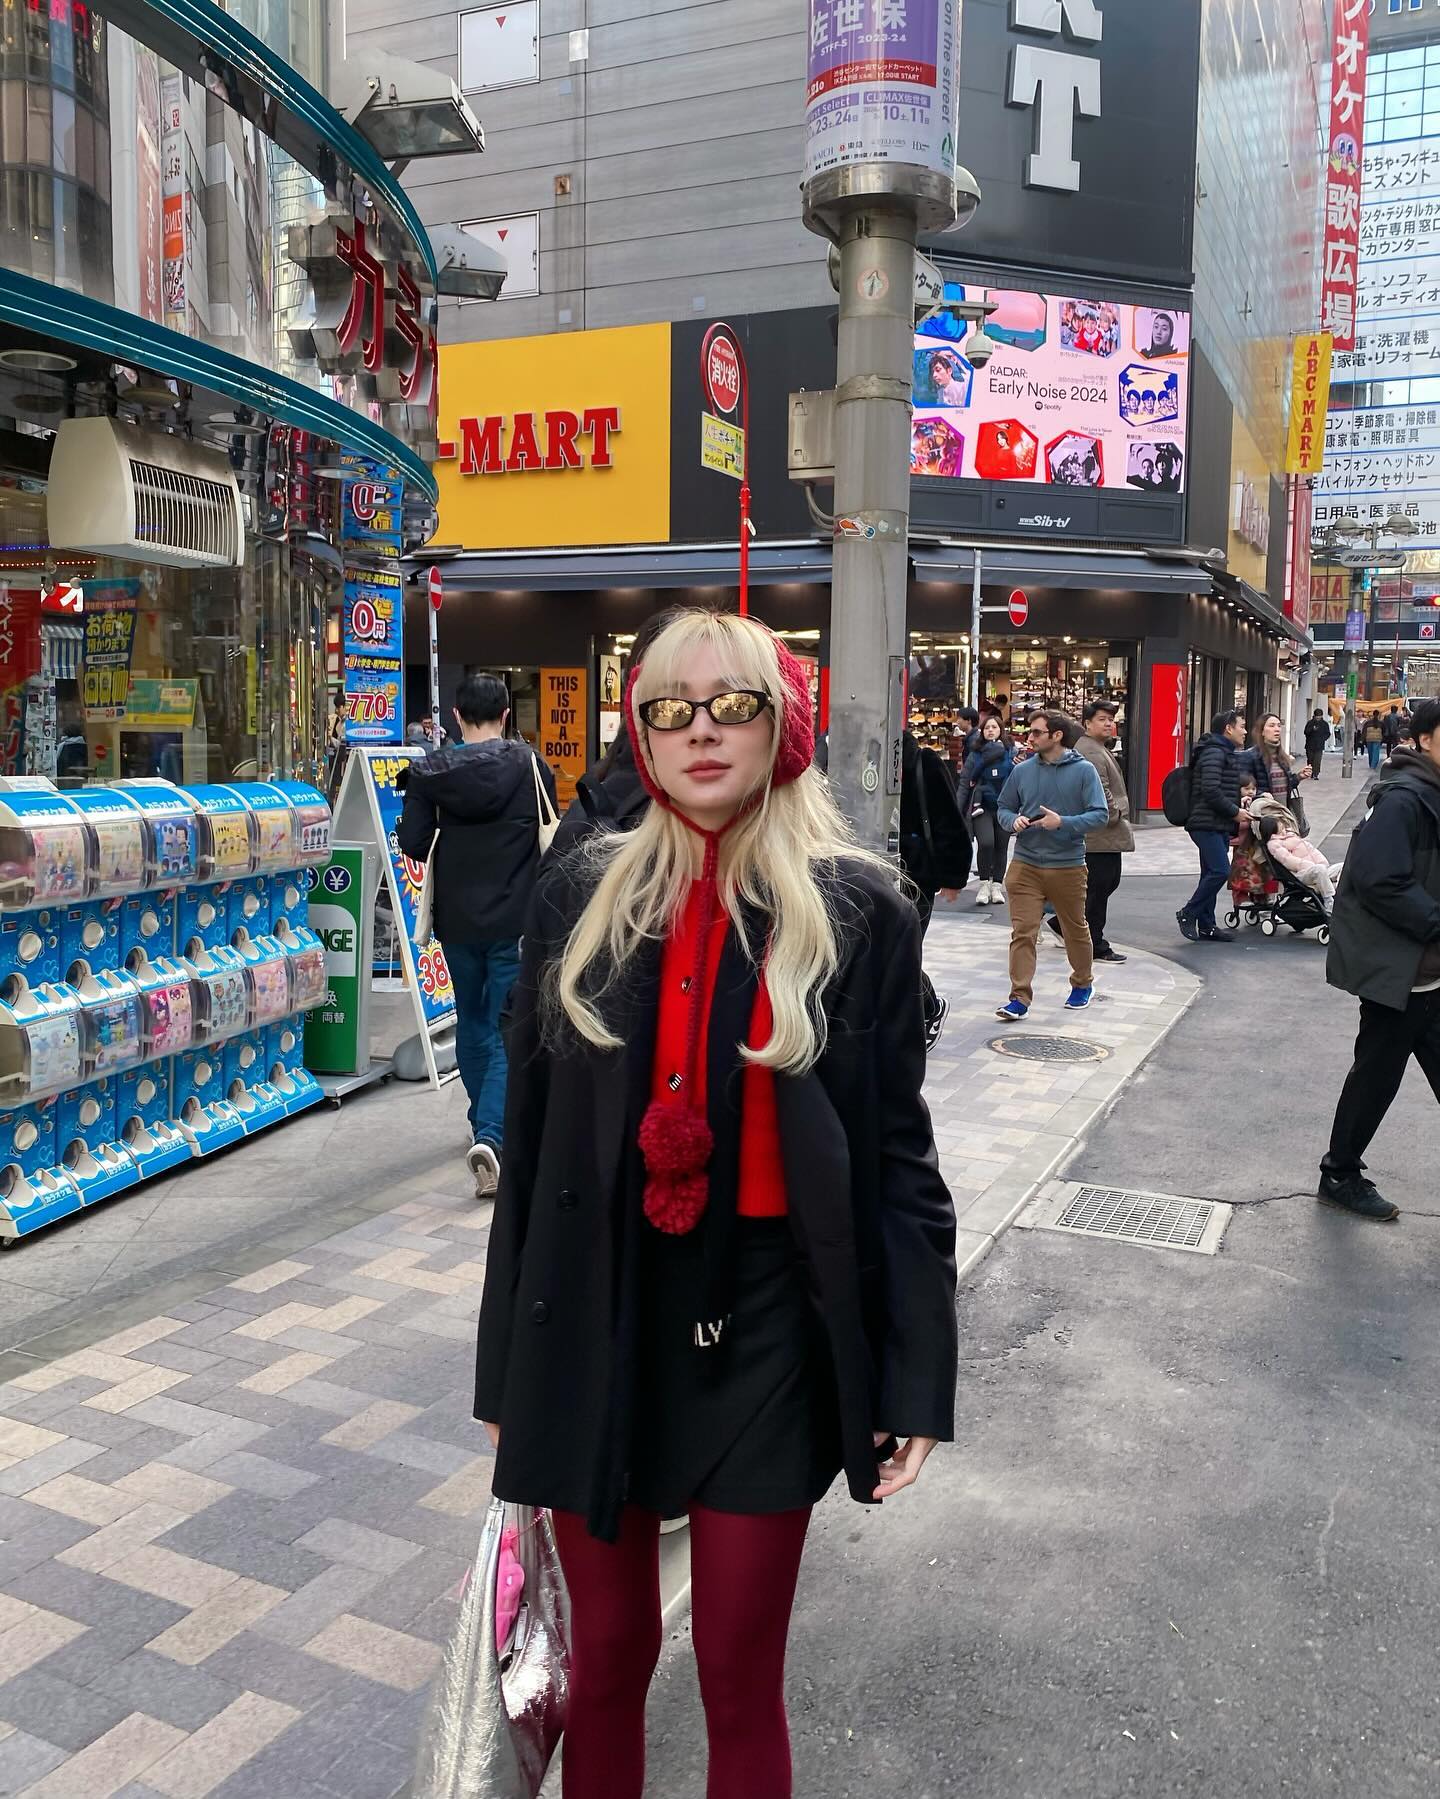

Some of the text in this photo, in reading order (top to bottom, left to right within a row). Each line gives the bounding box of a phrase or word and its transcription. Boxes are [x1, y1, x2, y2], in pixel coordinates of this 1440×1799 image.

[857, 33, 907, 44] 2023-24
[943, 31, 953, 61] the
[1333, 0, 1365, 124] オケ
[942, 68, 954, 123] street
[823, 97, 850, 113] Select
[1323, 184, 1358, 340] 歌広場
[711, 354, 737, 393] 消火栓
[990, 365, 1028, 379] RADAR:
[989, 378, 1108, 403] Early Noise 2024
[1044, 403, 1062, 411] Spotify
[1315, 503, 1420, 521] 日用品・医薬品
[86, 611, 133, 637] お荷物
[352, 600, 386, 639] 0円
[548, 676, 578, 691] THIS
[345, 692, 396, 720] 770円
[557, 692, 570, 707] IS
[551, 710, 576, 724] NOT
[559, 726, 567, 740] A
[545, 742, 582, 757] BOOT.
[323, 1012, 345, 1024] 両替
